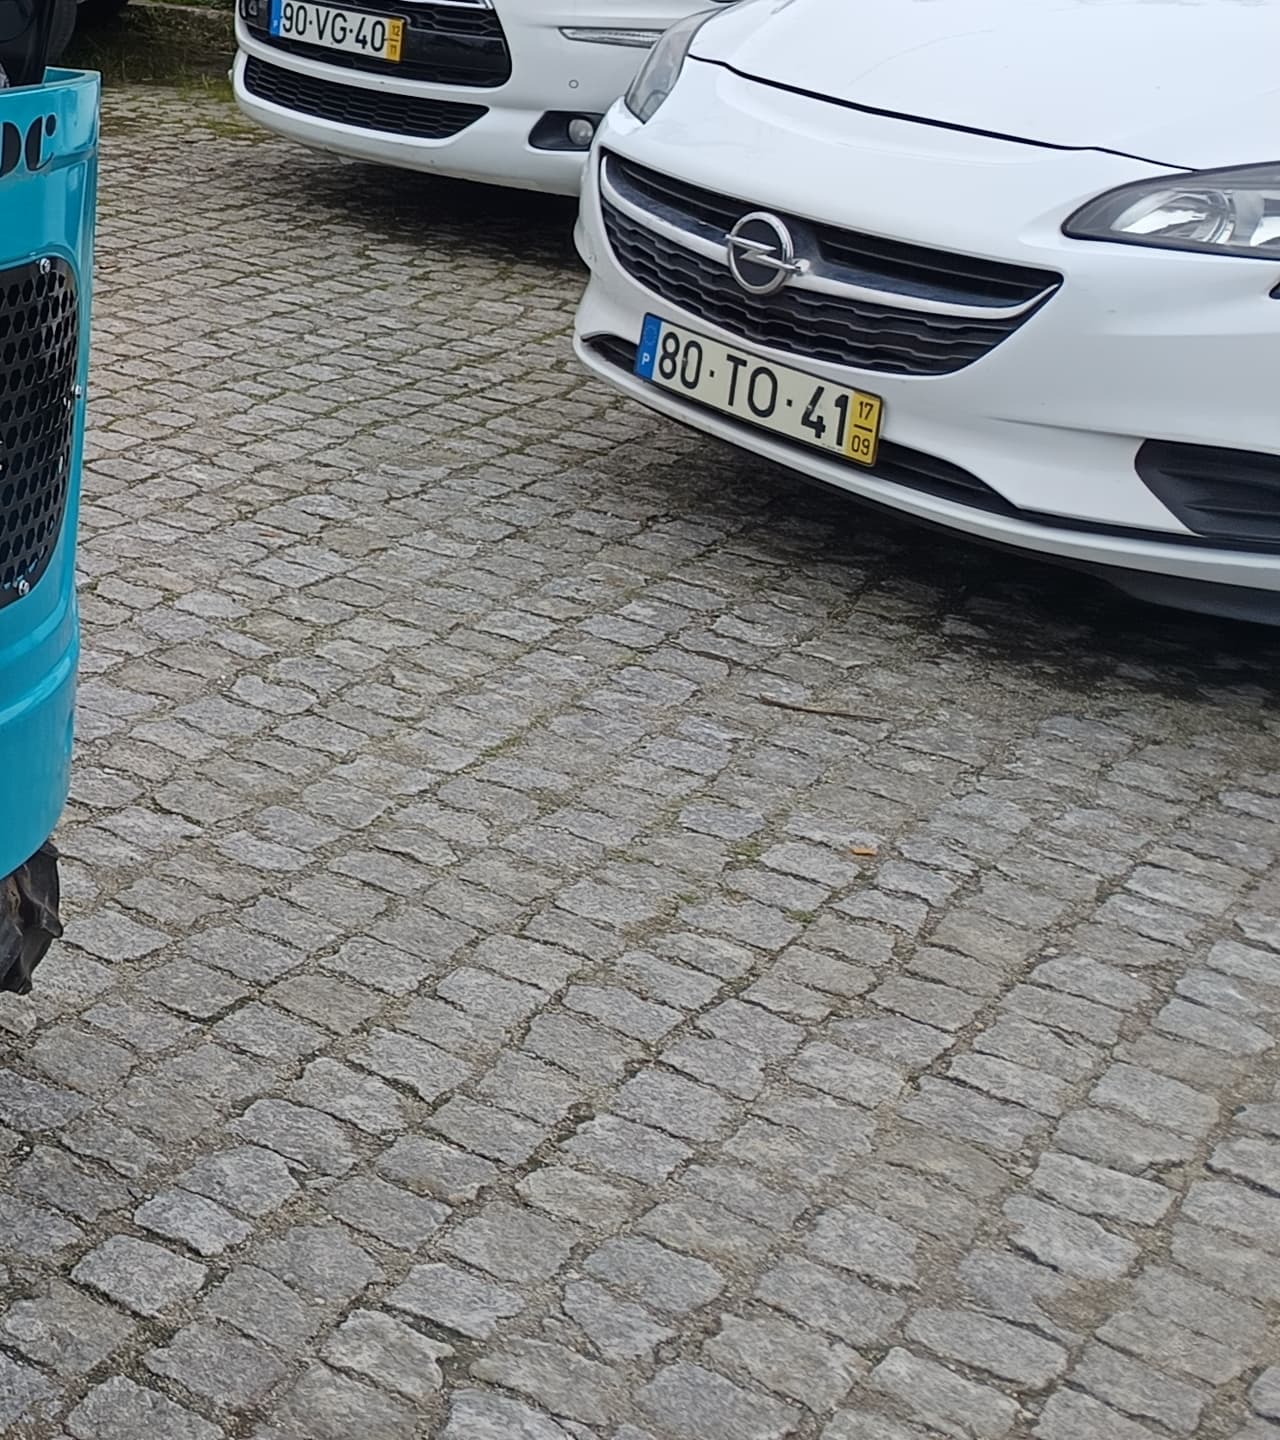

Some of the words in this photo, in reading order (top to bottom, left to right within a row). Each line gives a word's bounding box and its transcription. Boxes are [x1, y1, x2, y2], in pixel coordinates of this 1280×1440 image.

[641, 353, 650, 365] P
[858, 400, 874, 421] 17
[851, 435, 870, 456] 09
